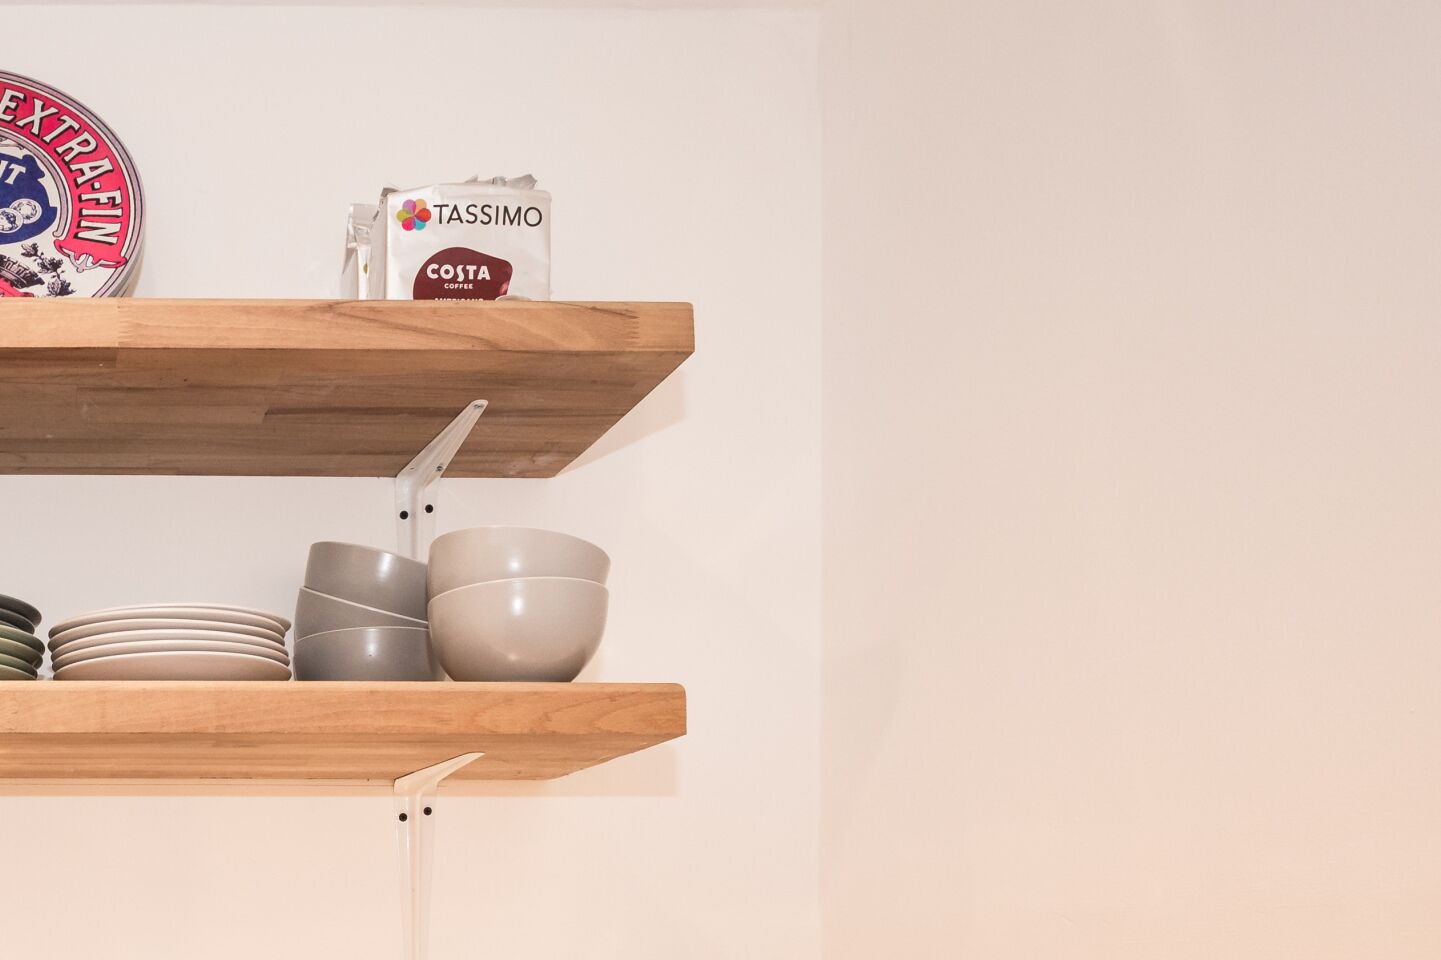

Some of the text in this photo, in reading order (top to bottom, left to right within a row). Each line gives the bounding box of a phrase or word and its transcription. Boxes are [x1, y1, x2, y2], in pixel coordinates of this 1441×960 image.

[433, 204, 543, 227] TASSIMO
[426, 263, 491, 281] COSTA
[444, 282, 474, 290] COFFEE
